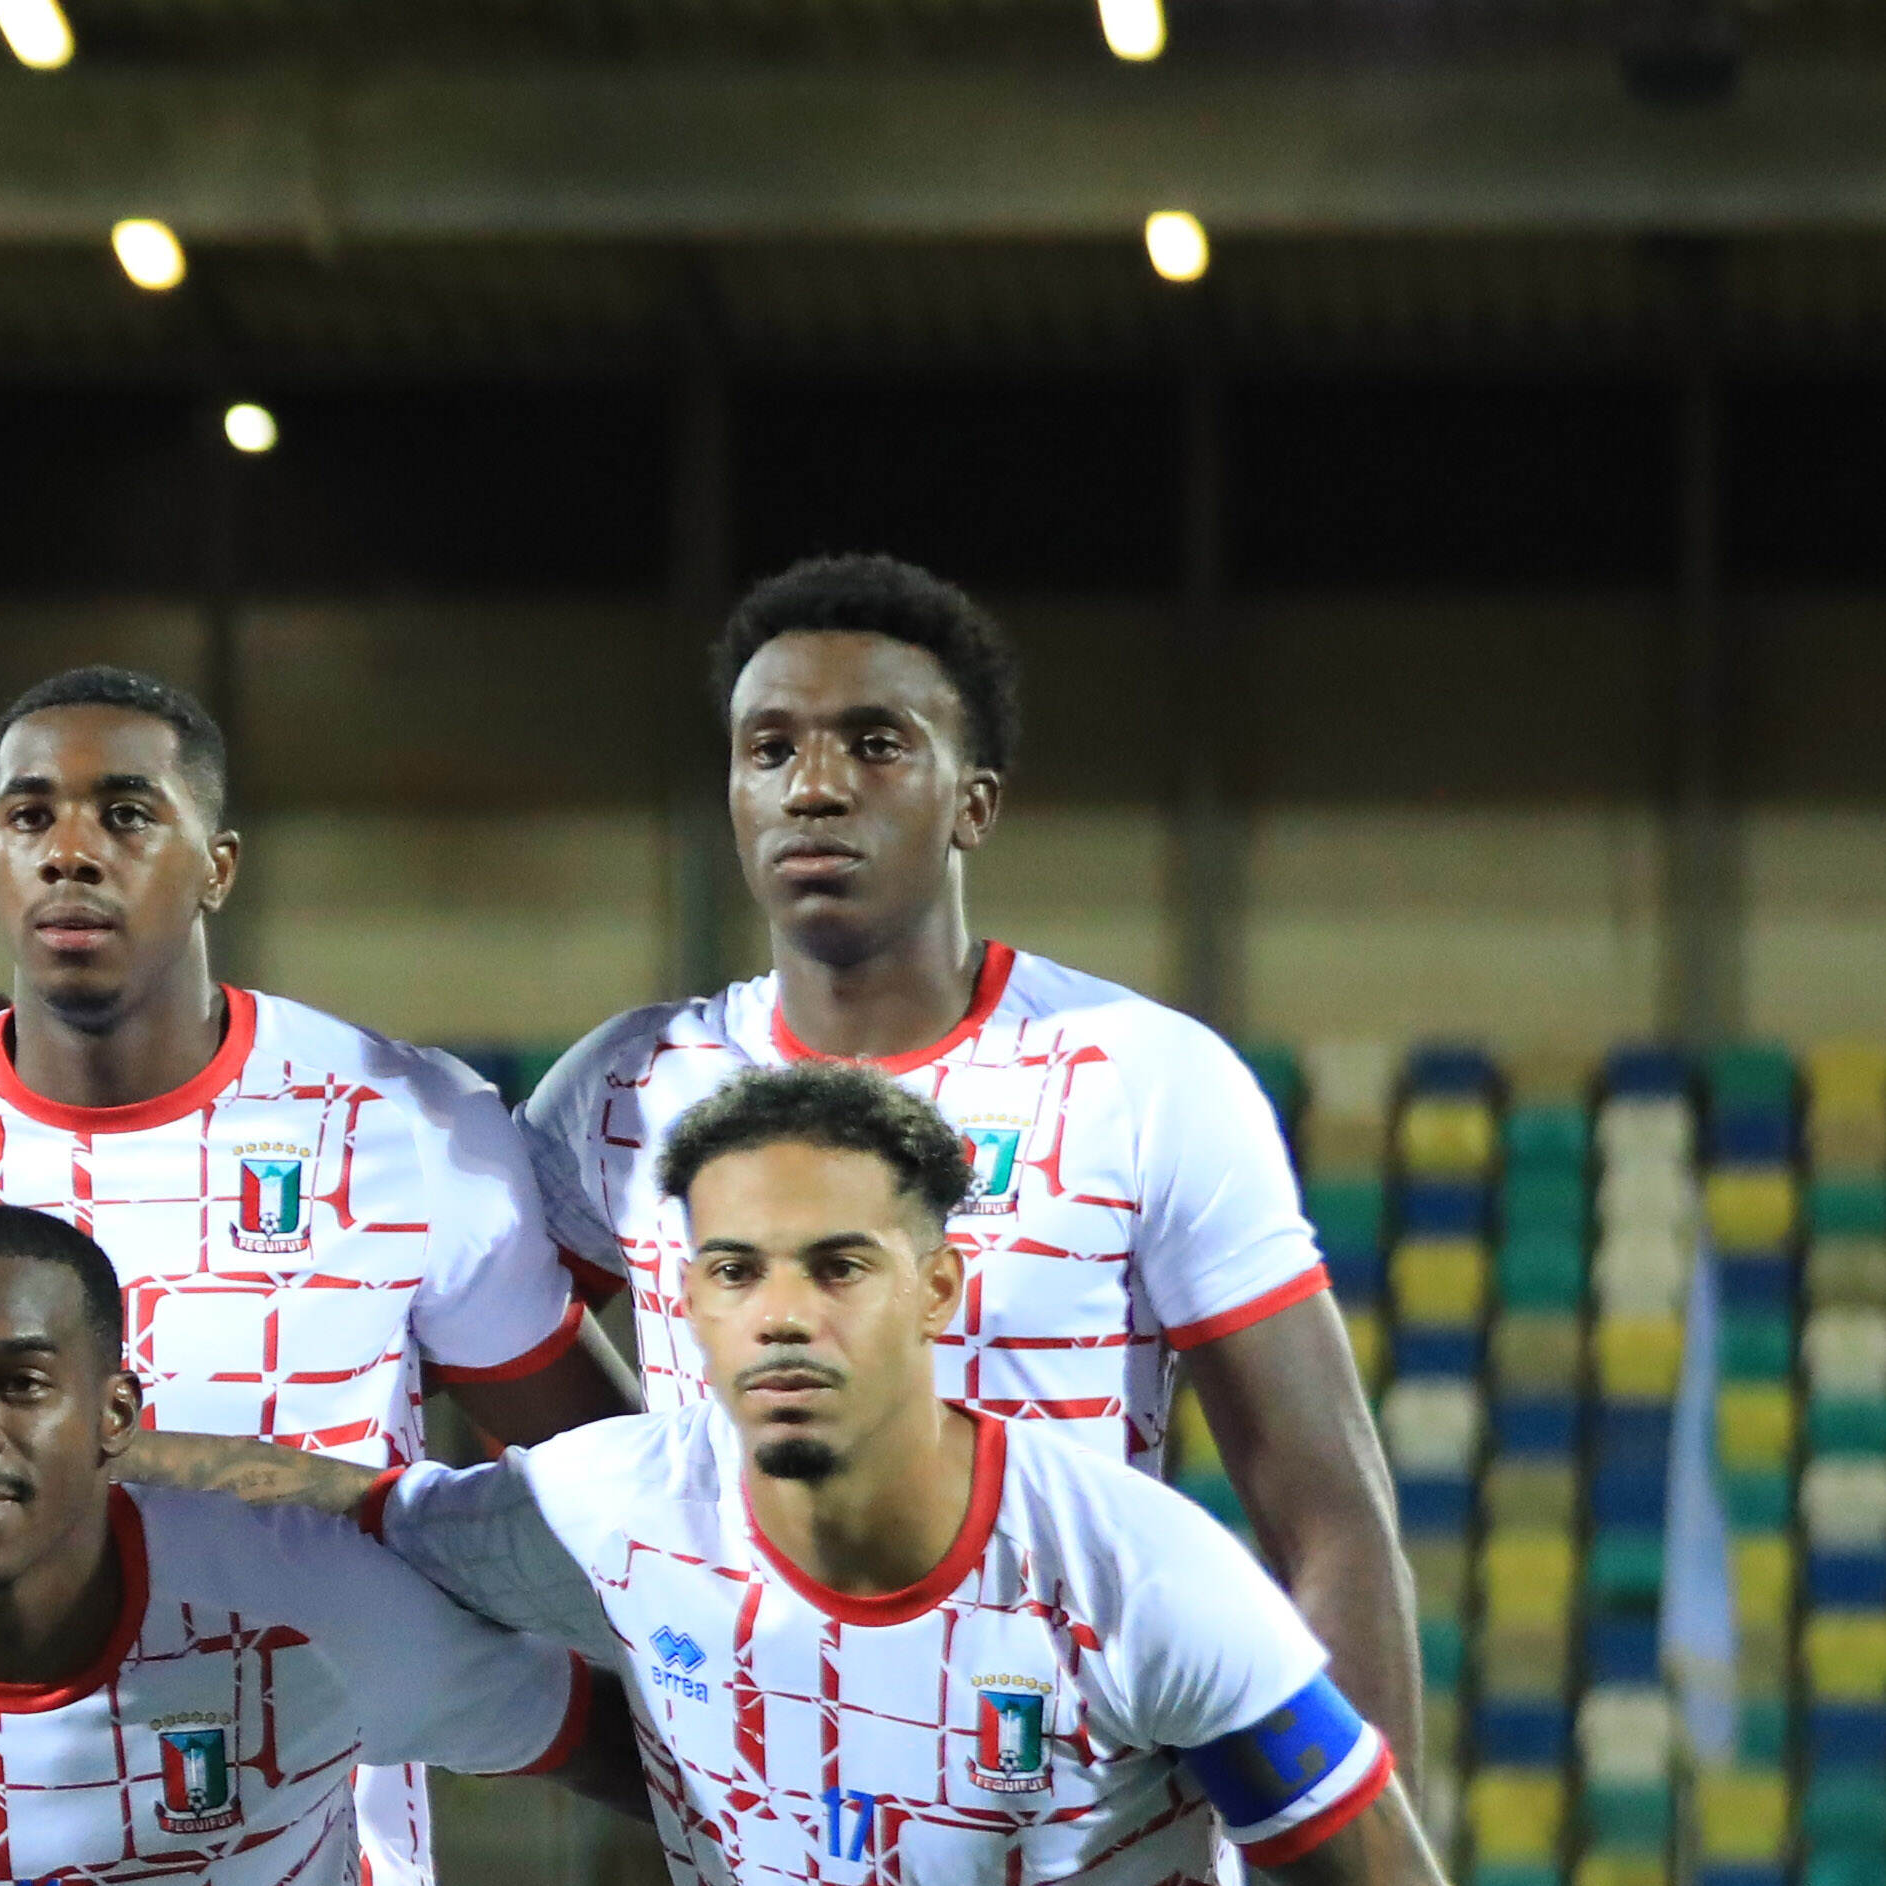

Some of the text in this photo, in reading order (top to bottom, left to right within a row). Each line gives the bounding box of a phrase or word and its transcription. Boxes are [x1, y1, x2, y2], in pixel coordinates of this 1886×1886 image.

[238, 1238, 302, 1253] FEGUIFUT
[650, 1664, 709, 1704] errea
[975, 1777, 1046, 1792] FEGUIFUT
[167, 1813, 234, 1832] FEGUIFUT
[821, 1786, 873, 1862] 17
